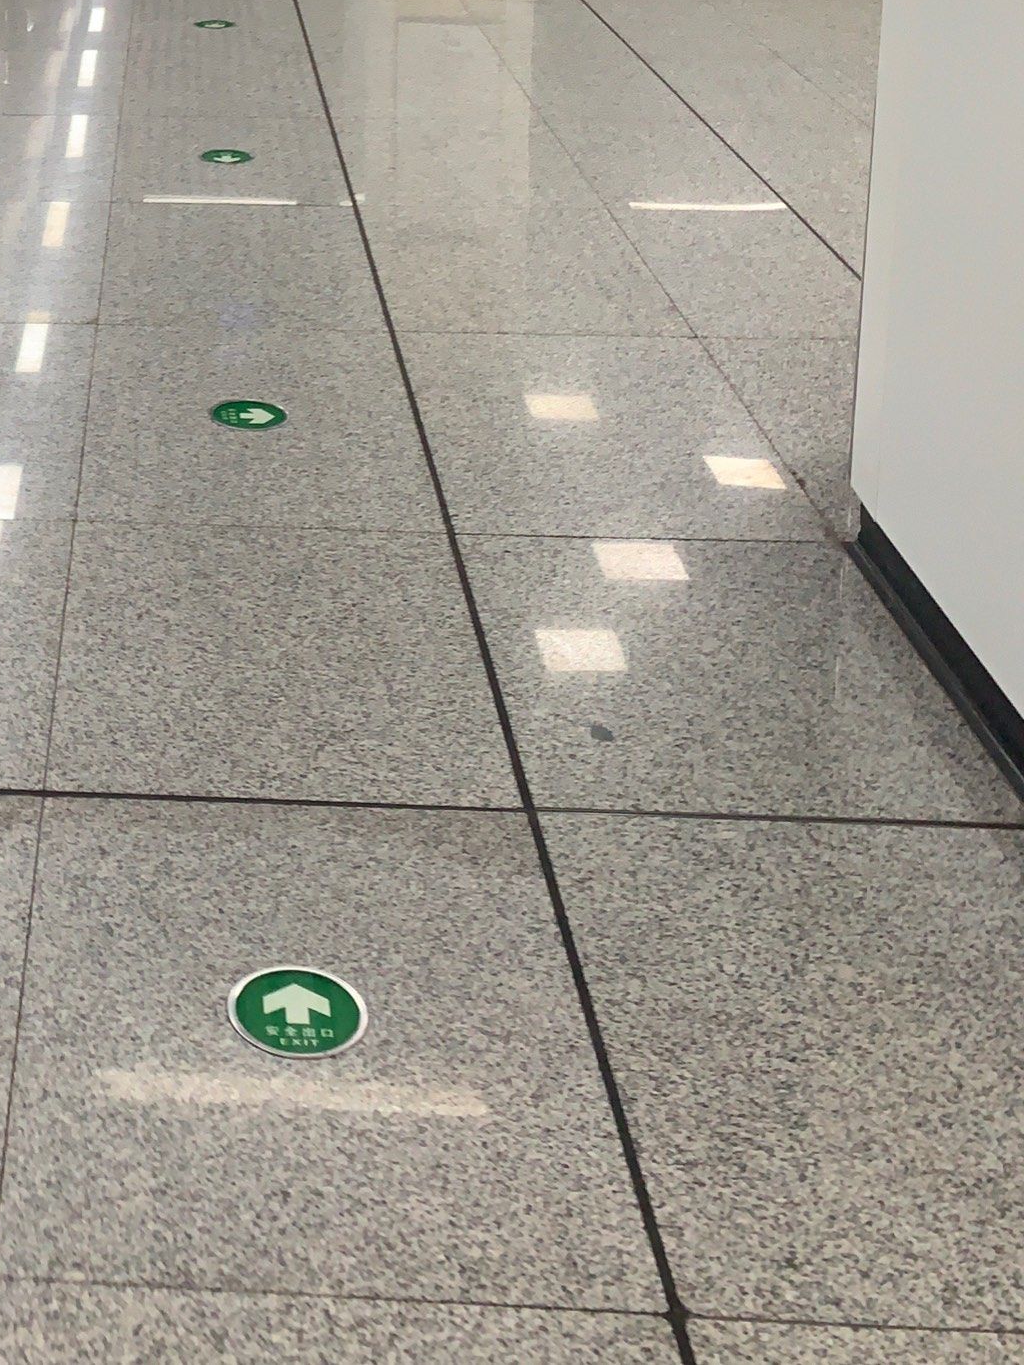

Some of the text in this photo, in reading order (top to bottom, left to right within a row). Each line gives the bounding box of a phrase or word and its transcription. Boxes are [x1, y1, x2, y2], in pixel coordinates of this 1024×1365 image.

[265, 1025, 334, 1037] 安全出口
[279, 1038, 319, 1047] EXIT
